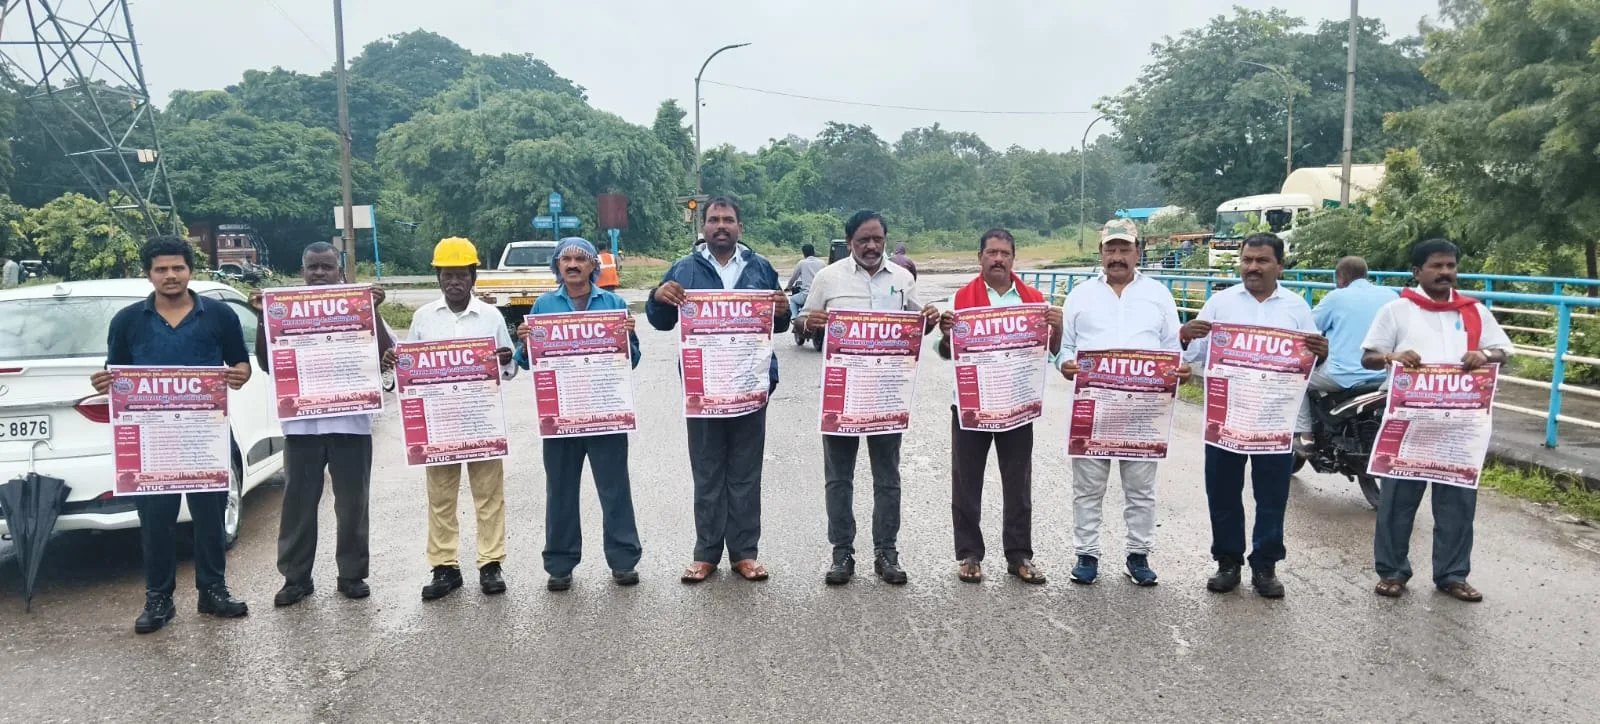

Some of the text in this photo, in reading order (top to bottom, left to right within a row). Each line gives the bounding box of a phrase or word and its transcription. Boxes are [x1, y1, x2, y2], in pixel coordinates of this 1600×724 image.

[290, 298, 349, 318] AITUC
[700, 301, 753, 318] AITUC
[551, 323, 607, 340] AITUC
[848, 322, 903, 339] AITUC
[973, 315, 1028, 336] AITUC
[1232, 332, 1294, 356] AITUC
[417, 349, 475, 369] AITUC
[1097, 357, 1156, 377] AITUC
[137, 377, 202, 394] AITUC
[1413, 373, 1474, 392] AITUC
[296, 408, 323, 416] AITUC
[10, 420, 47, 436] 8876
[1218, 439, 1239, 449] AITUC
[1388, 469, 1415, 477] AITUC
